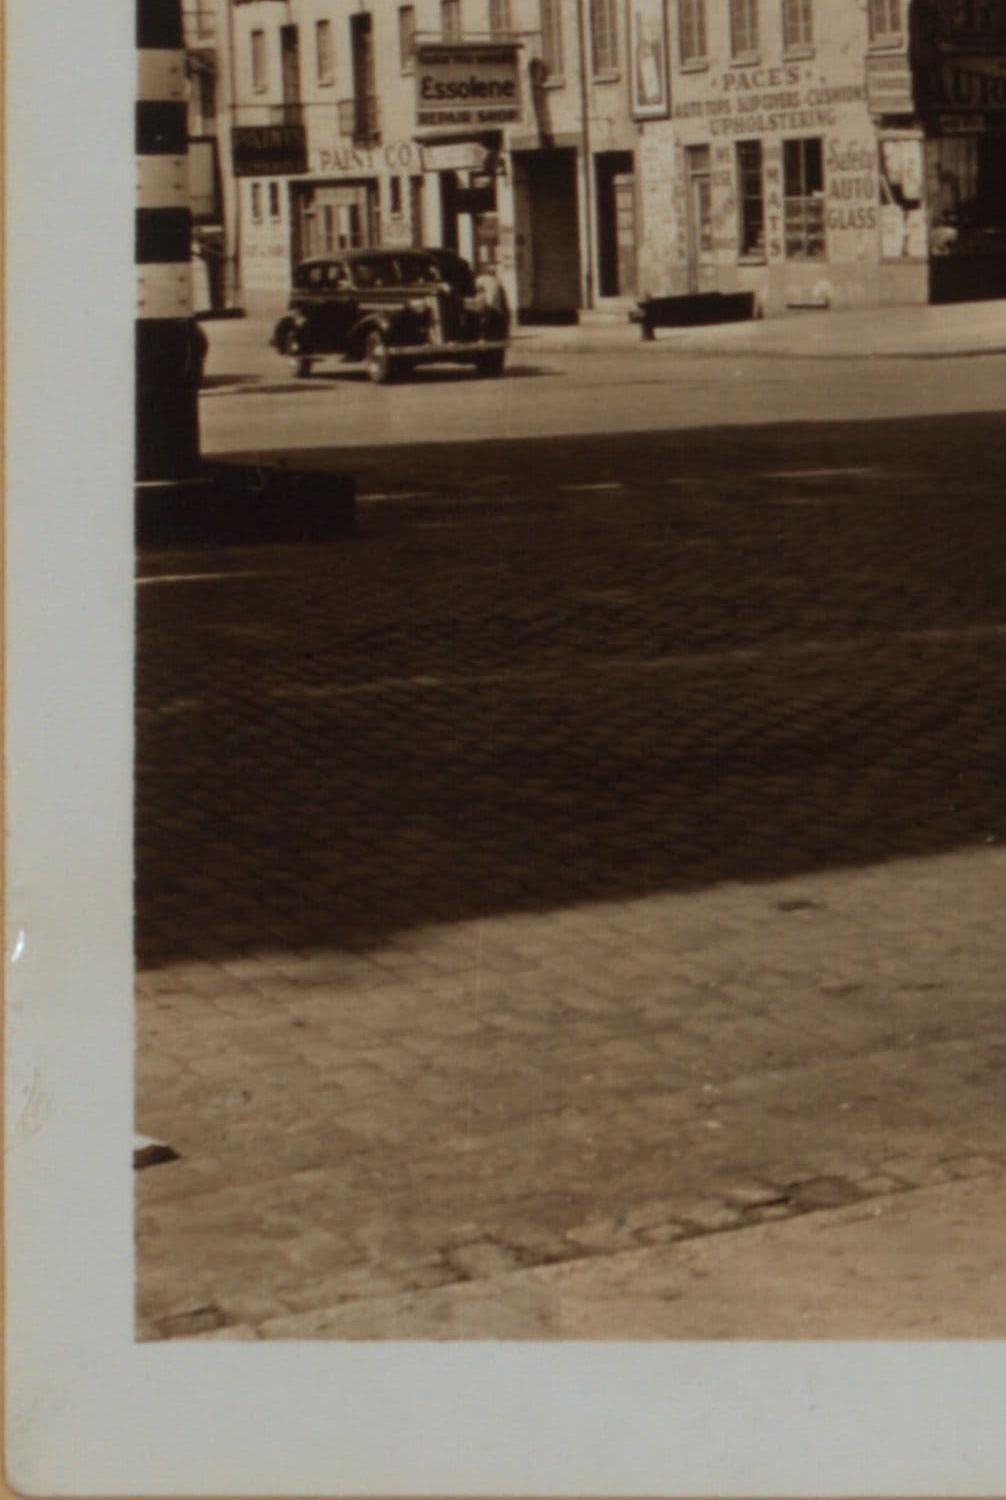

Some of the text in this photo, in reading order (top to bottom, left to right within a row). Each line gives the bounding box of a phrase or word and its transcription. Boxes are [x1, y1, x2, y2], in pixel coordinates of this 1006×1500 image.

[421, 74, 516, 100] Essolene
[709, 108, 836, 136] UPHOLSTERING
[318, 148, 374, 171] PAINT
[829, 177, 874, 201] AUTO
[828, 206, 877, 231] GLASS
